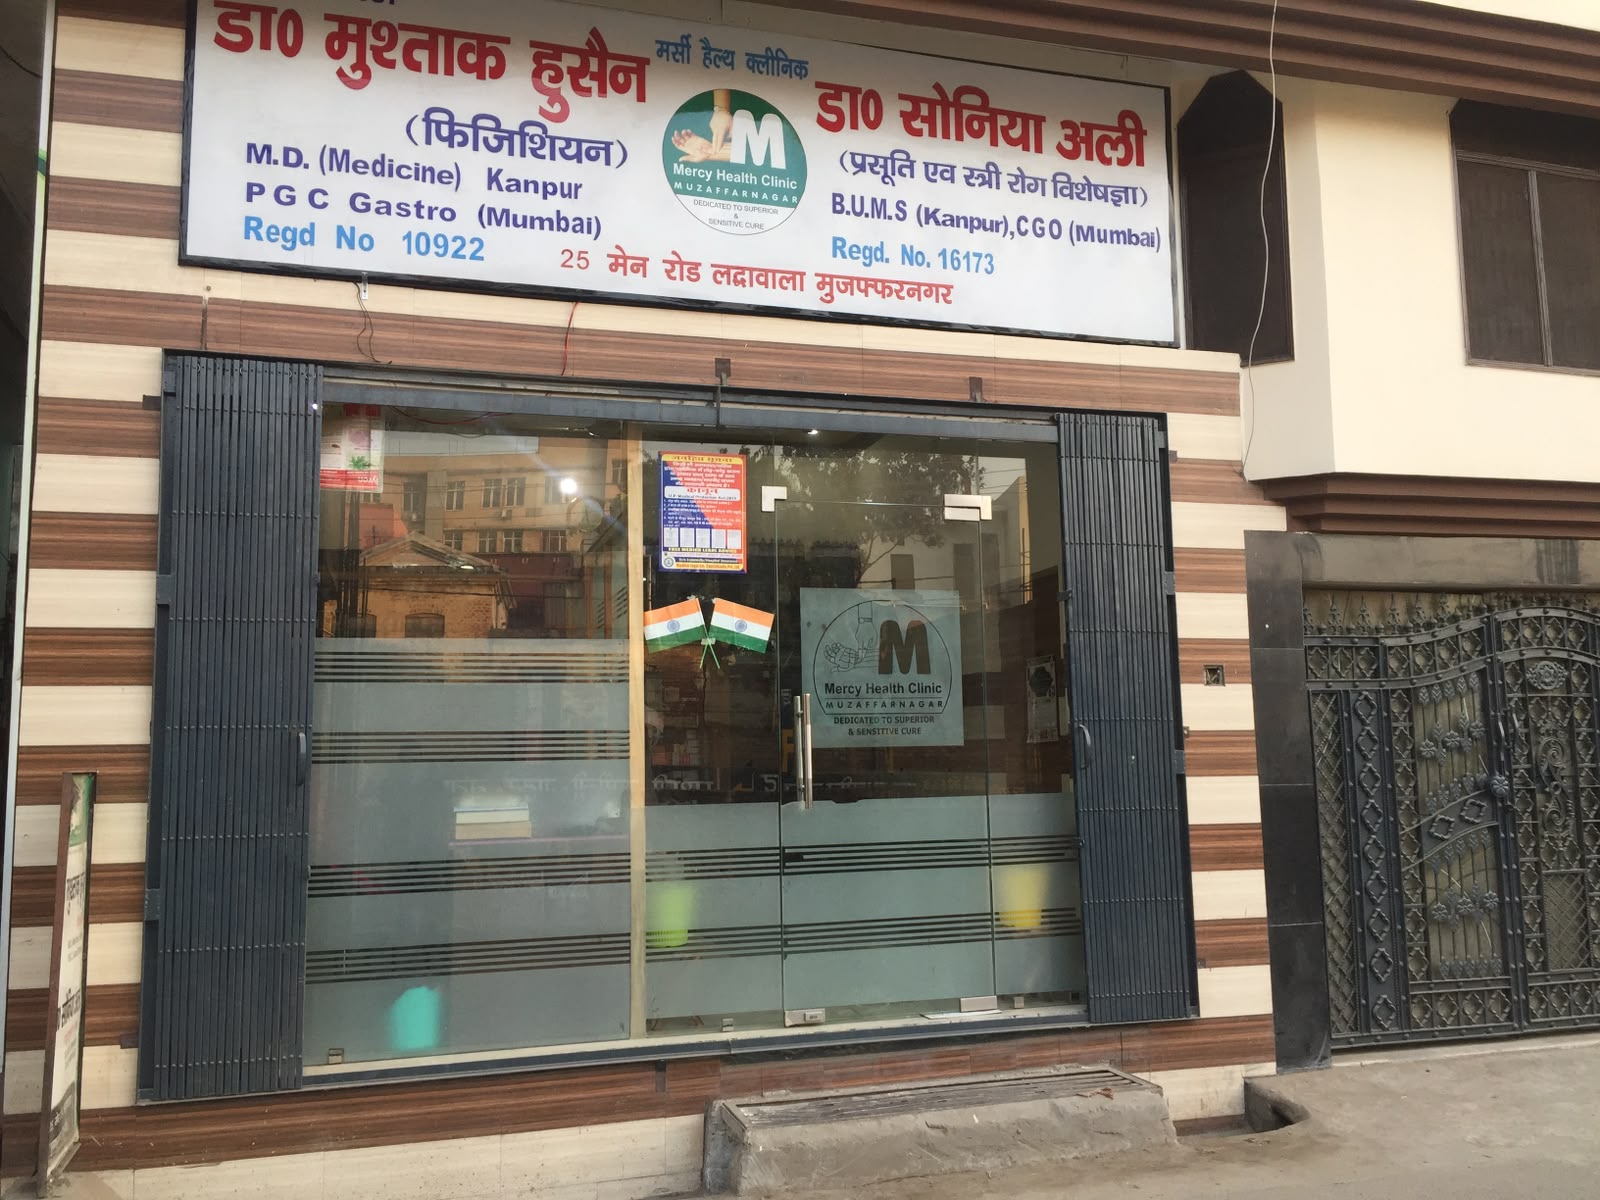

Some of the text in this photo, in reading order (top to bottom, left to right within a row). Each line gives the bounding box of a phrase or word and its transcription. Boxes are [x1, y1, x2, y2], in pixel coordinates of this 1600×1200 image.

[324, 13, 510, 90] मुश्ताक
[529, 27, 650, 123] हुसैन
[656, 34, 692, 65] मर्सी
[746, 47, 809, 80] क्लीनिक
[730, 109, 786, 169] M
[898, 82, 1046, 154] सोनिया
[1056, 109, 1147, 167] अली
[246, 143, 583, 202] M.D. (Medicine) Kanpur
[673, 163, 797, 189] Mercy Health Clinic
[674, 182, 798, 204] MUZAFFARNAGAR
[1007, 167, 1047, 198] रोग
[350, 192, 457, 222] Gastro
[477, 204, 602, 241] (Mumbai)
[694, 199, 731, 210] DEDICATED
[744, 206, 778, 214] SUPERIOR
[709, 218, 743, 228] SENSITIVE
[832, 192, 908, 221] B.U.M.S
[1069, 219, 1161, 253] (Mumbai)
[244, 216, 485, 261] Regd No 10922
[832, 237, 995, 275] Regd. No. 16173
[560, 248, 590, 270] 25
[607, 245, 650, 280] मेन
[664, 251, 701, 283] रोड
[815, 271, 954, 305] मुजफ्फरनगर
[878, 620, 931, 675] M
[825, 683, 942, 696] Mercy Health Clinic
[825, 701, 943, 709] MUZAFFARNAGAR
[856, 728, 899, 736] SENSITIVE
[901, 727, 922, 735] CURE
